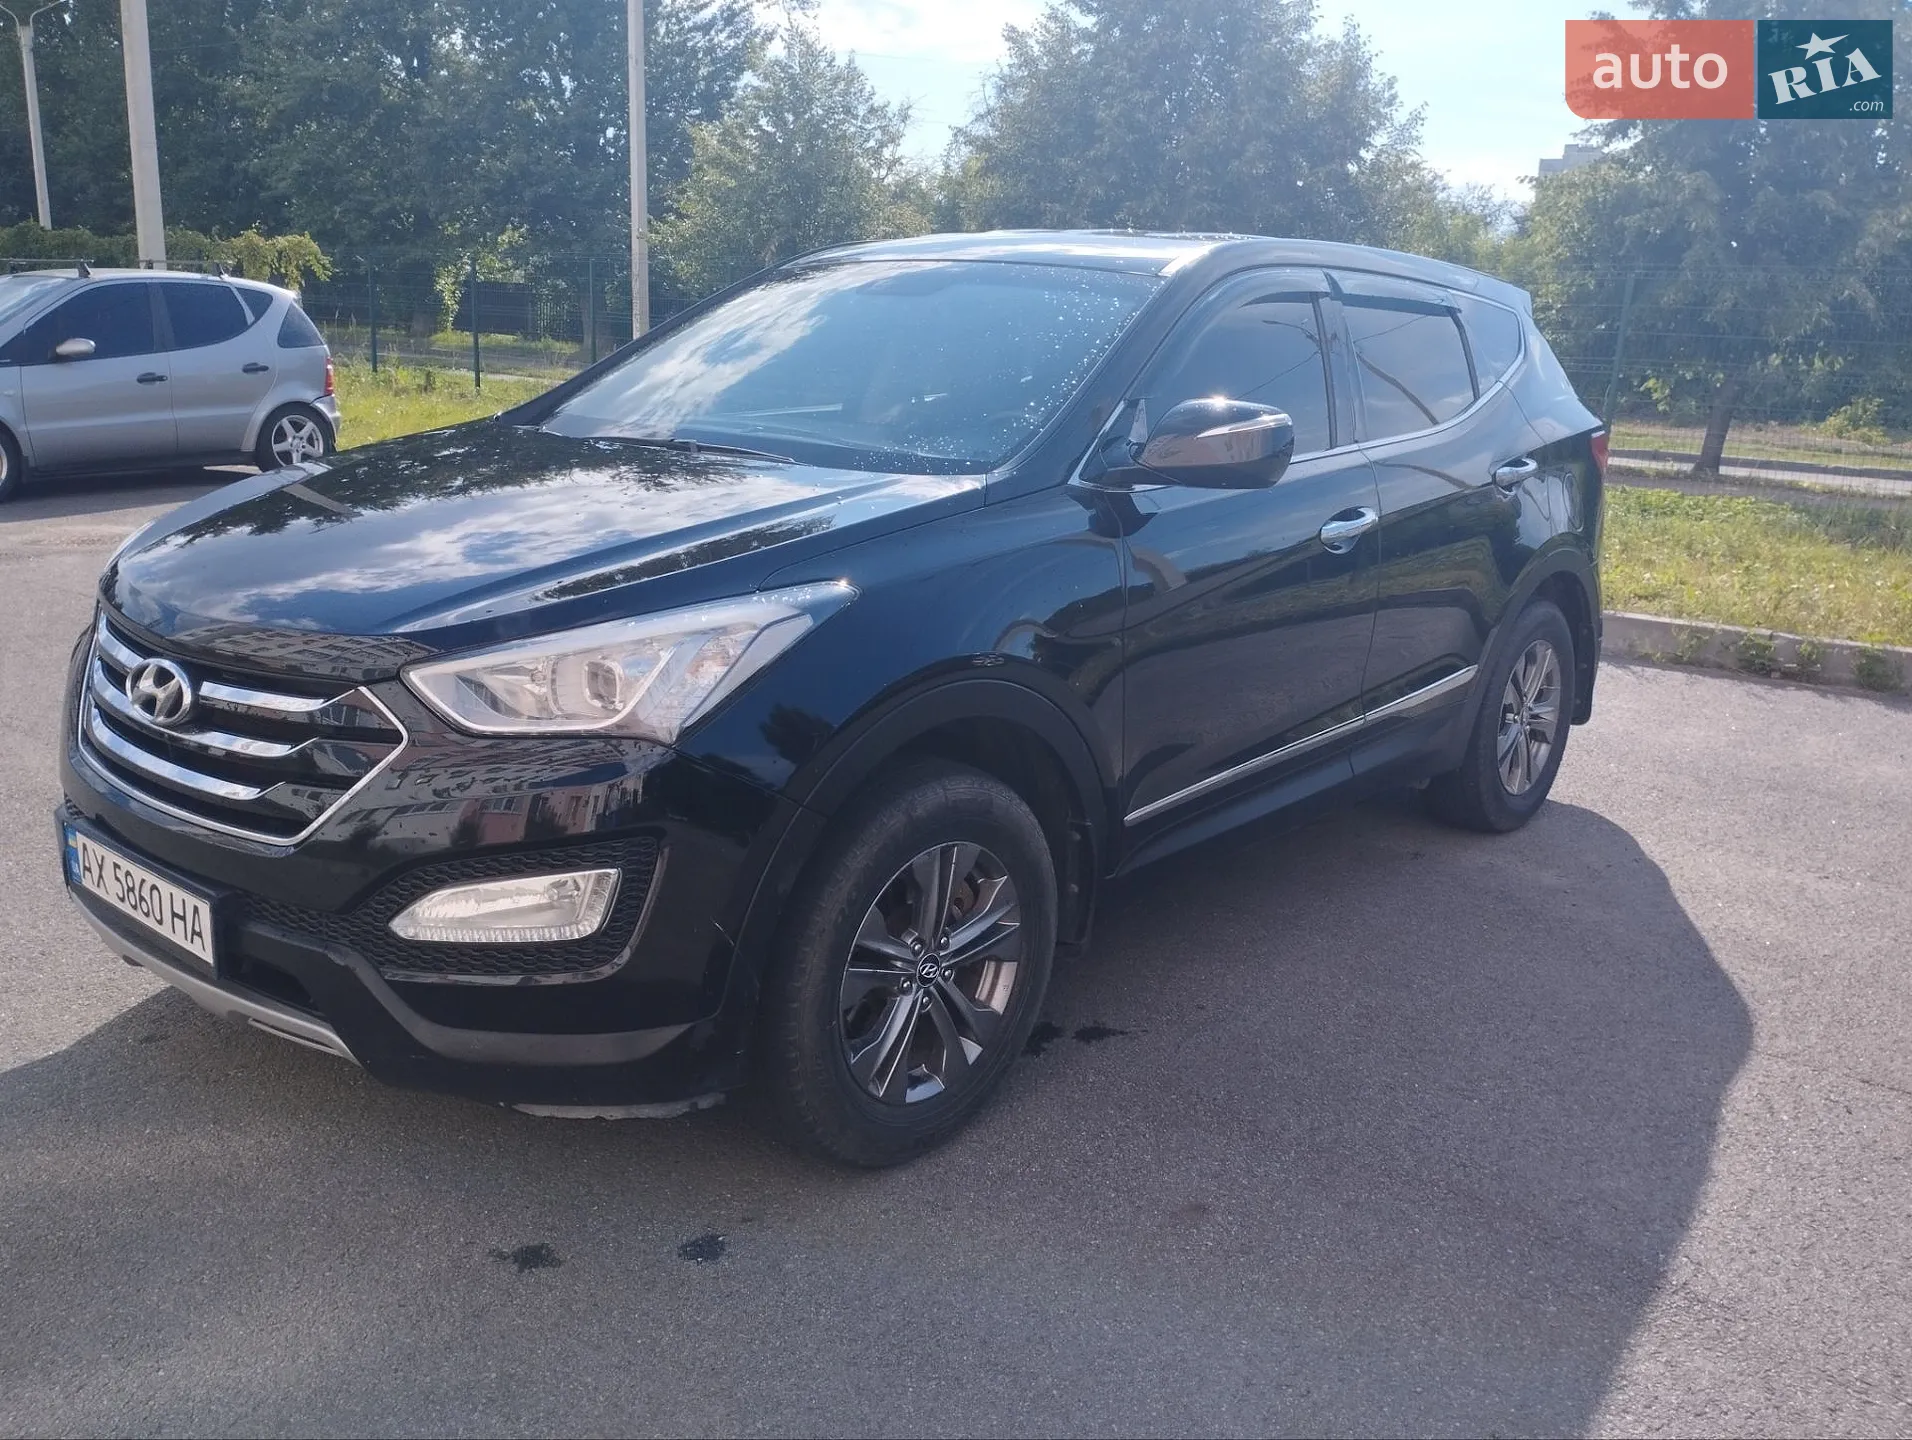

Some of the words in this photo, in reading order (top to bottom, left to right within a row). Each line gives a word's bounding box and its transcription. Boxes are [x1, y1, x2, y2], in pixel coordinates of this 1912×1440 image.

[82, 842, 109, 895] AX
[112, 861, 164, 926] 5860
[170, 892, 206, 952] HA
